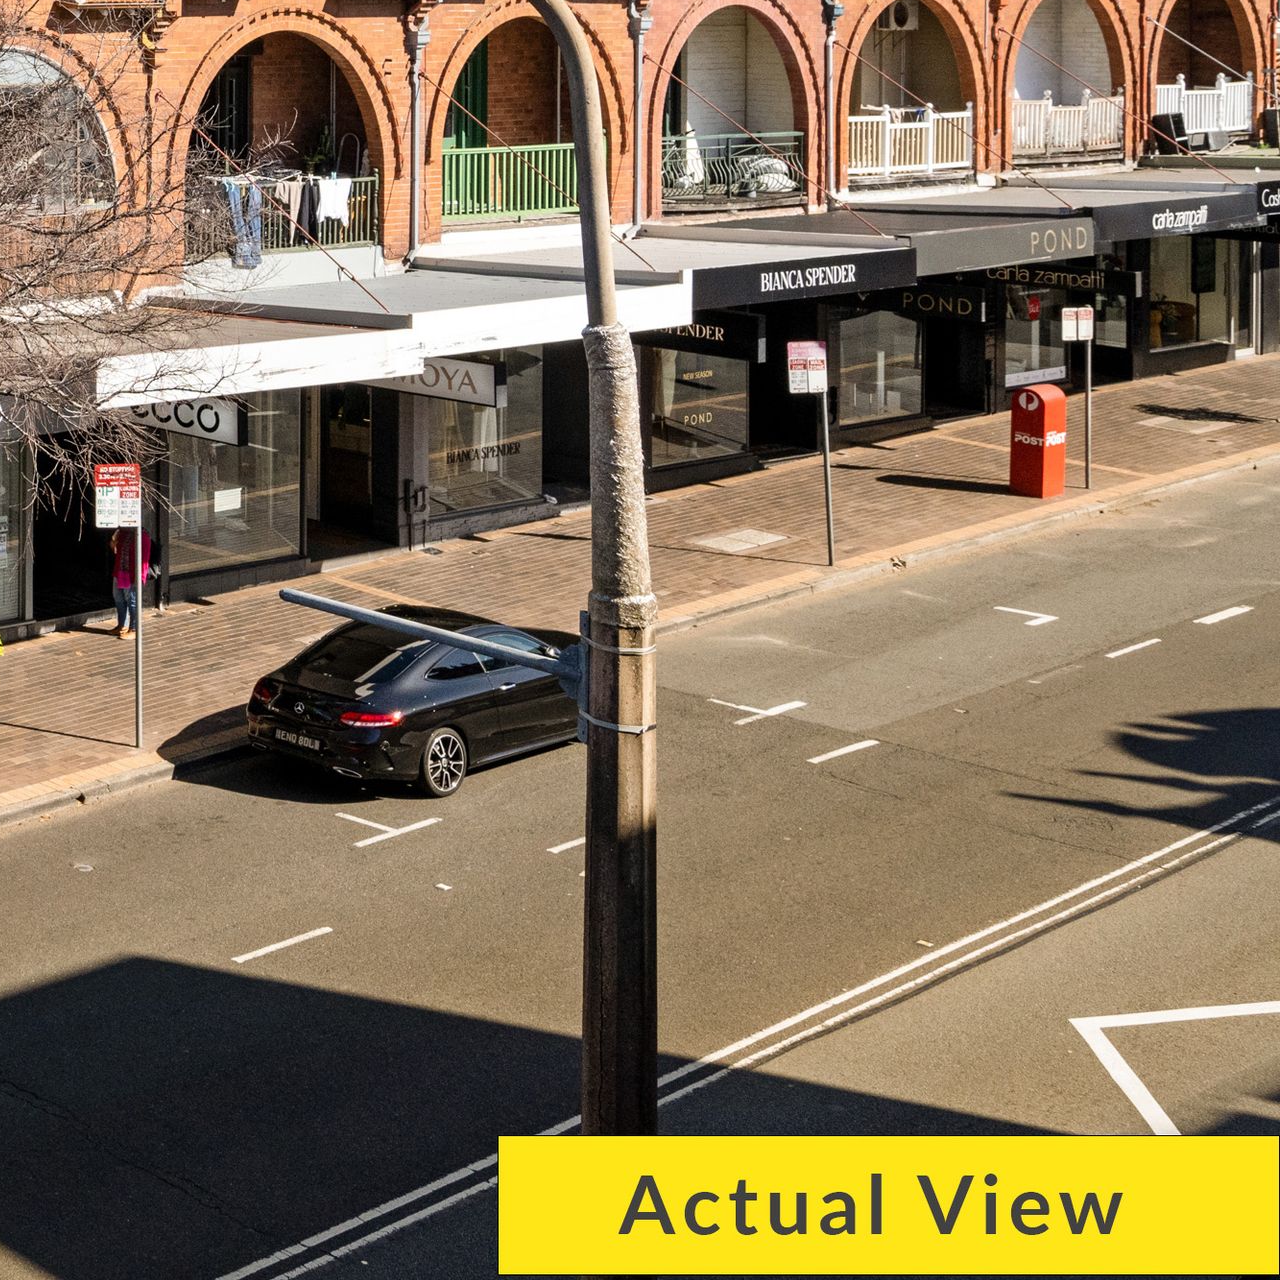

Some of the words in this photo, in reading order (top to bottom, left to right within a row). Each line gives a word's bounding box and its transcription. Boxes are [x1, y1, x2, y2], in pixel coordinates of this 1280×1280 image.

[1030, 227, 1088, 255] POND
[760, 269, 804, 293] BIANCA
[805, 263, 856, 287] SPENDER
[986, 265, 1030, 283] carla
[1033, 269, 1105, 289] zampatti
[902, 292, 973, 315] POND
[659, 324, 725, 341] ENDER
[683, 371, 695, 380] NEW
[695, 369, 713, 379] SEASON
[683, 412, 713, 425] POND
[1015, 433, 1044, 447] POST
[1045, 432, 1066, 447] POST
[446, 448, 480, 465] BIANCA
[481, 441, 521, 460] SPENDER
